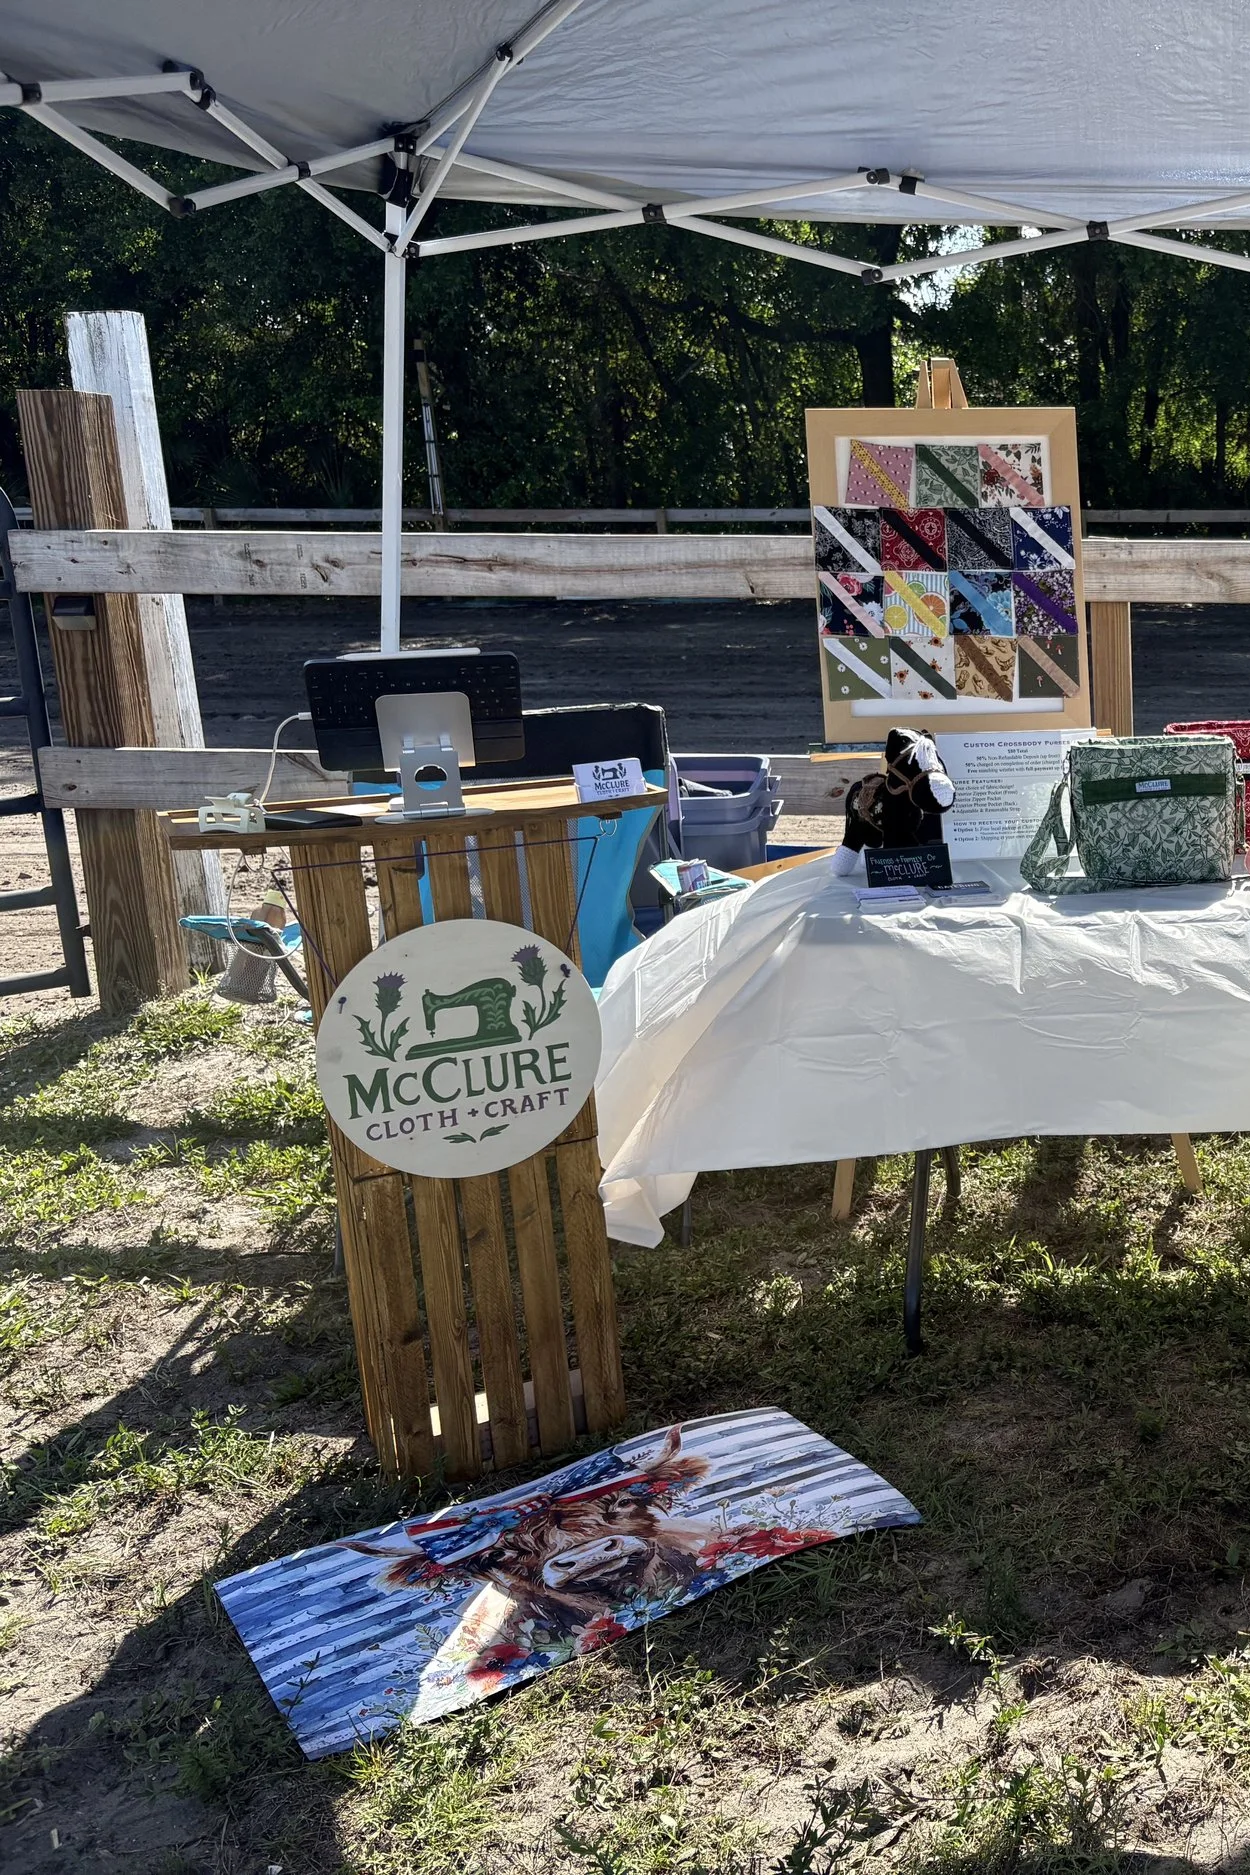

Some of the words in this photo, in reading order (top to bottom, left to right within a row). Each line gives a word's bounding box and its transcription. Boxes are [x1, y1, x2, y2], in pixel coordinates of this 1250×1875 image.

[594, 780, 630, 791] McCLURE
[342, 1042, 572, 1121] McCLURE
[366, 1107, 459, 1142] CLOTH
[484, 1088, 570, 1119] CRAFT
